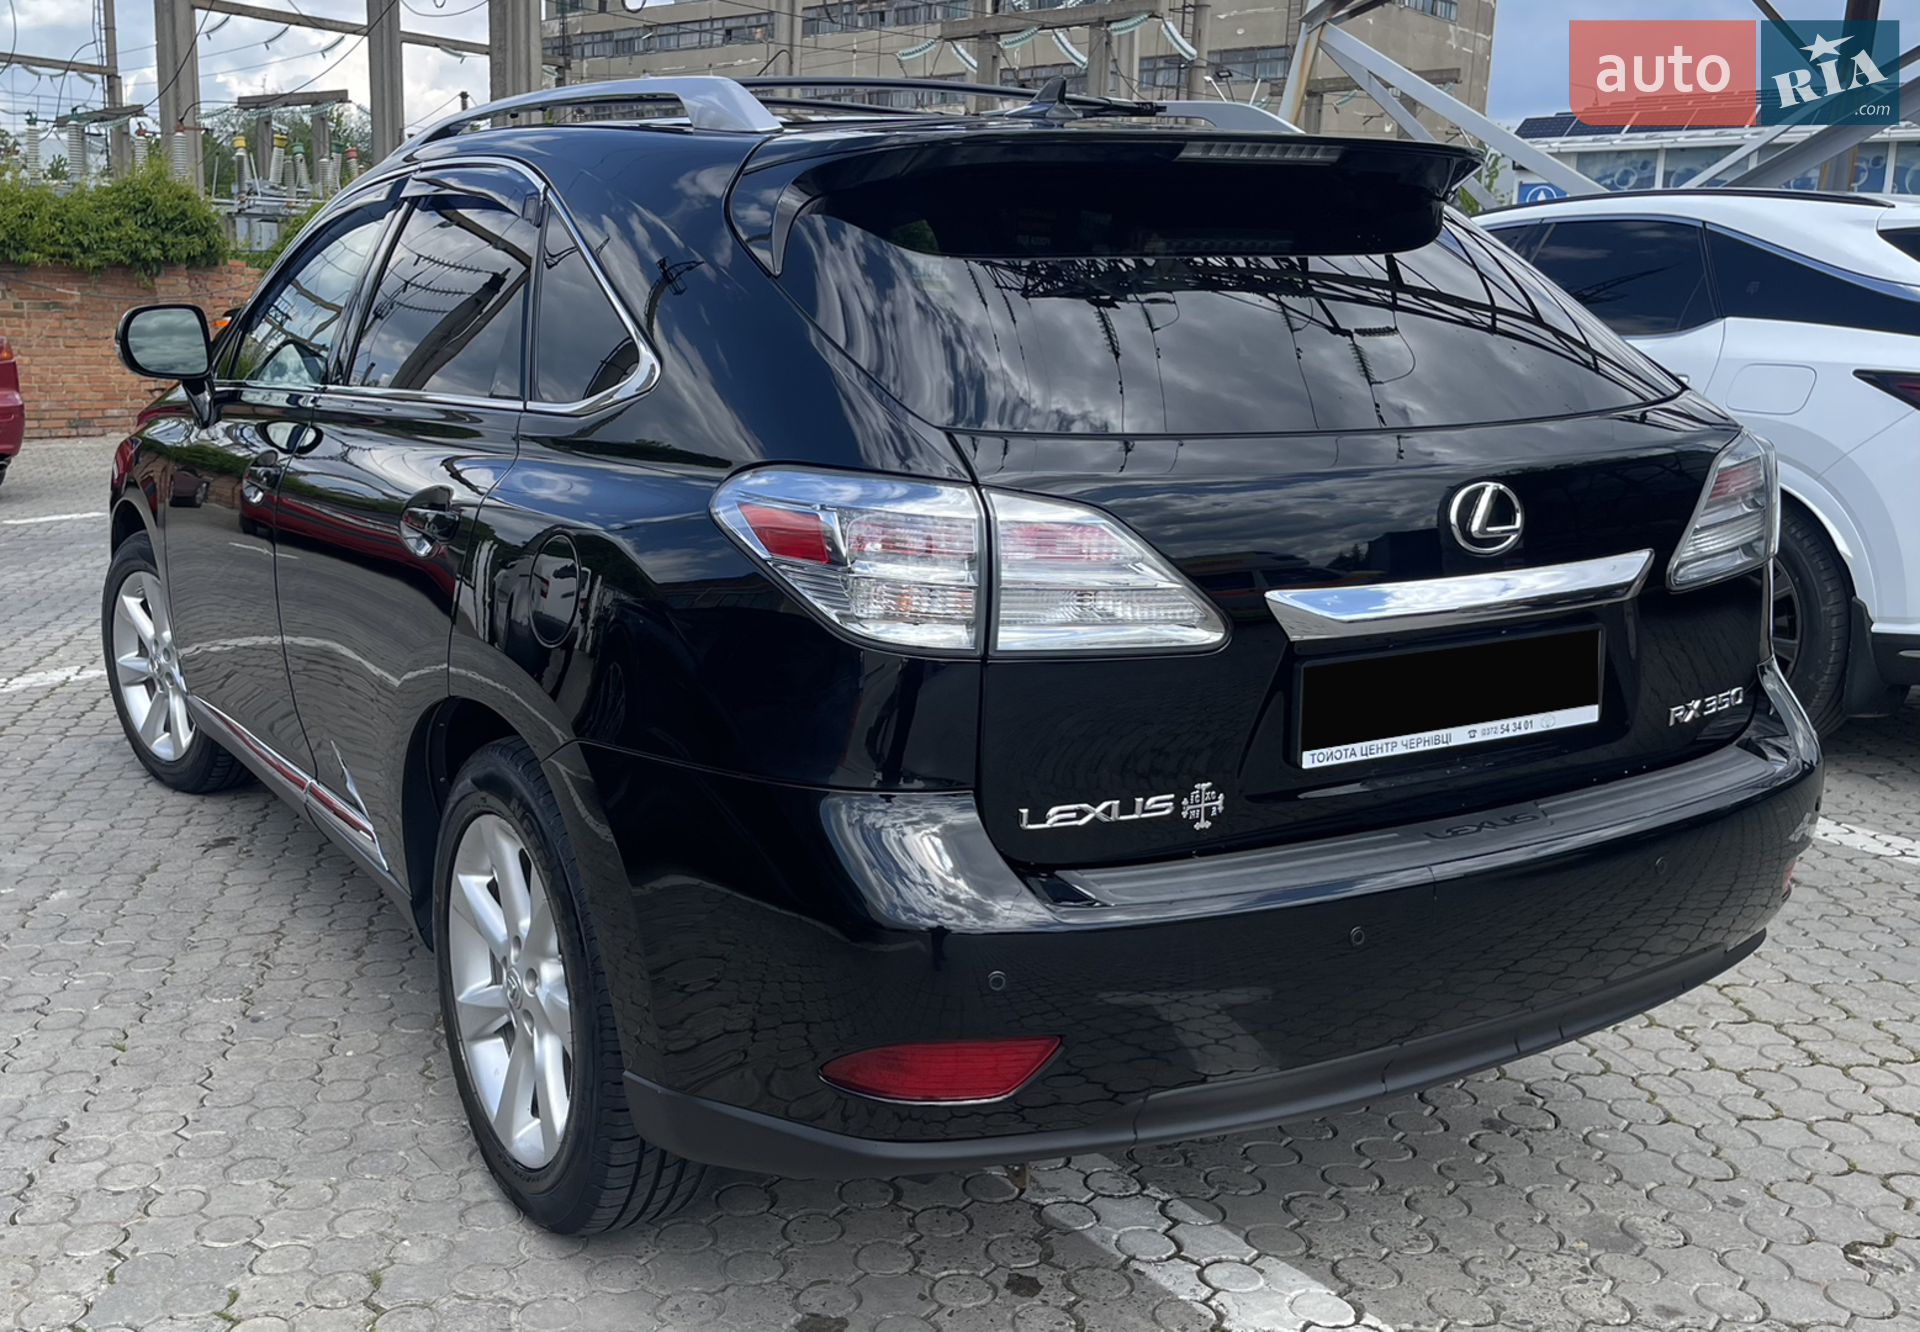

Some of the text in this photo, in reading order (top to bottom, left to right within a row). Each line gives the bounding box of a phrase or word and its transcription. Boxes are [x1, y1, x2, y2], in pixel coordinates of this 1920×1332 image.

[1669, 687, 1744, 727] RX 350
[1360, 741, 1398, 758] ЦЕНТР
[1401, 732, 1452, 750] ЧЕРНІВЦІ
[1500, 723, 1510, 735] 54
[1512, 721, 1523, 733] 34
[1523, 719, 1534, 731] 01
[1018, 793, 1176, 831] LEXUS
[1423, 813, 1540, 840] LEXUS
